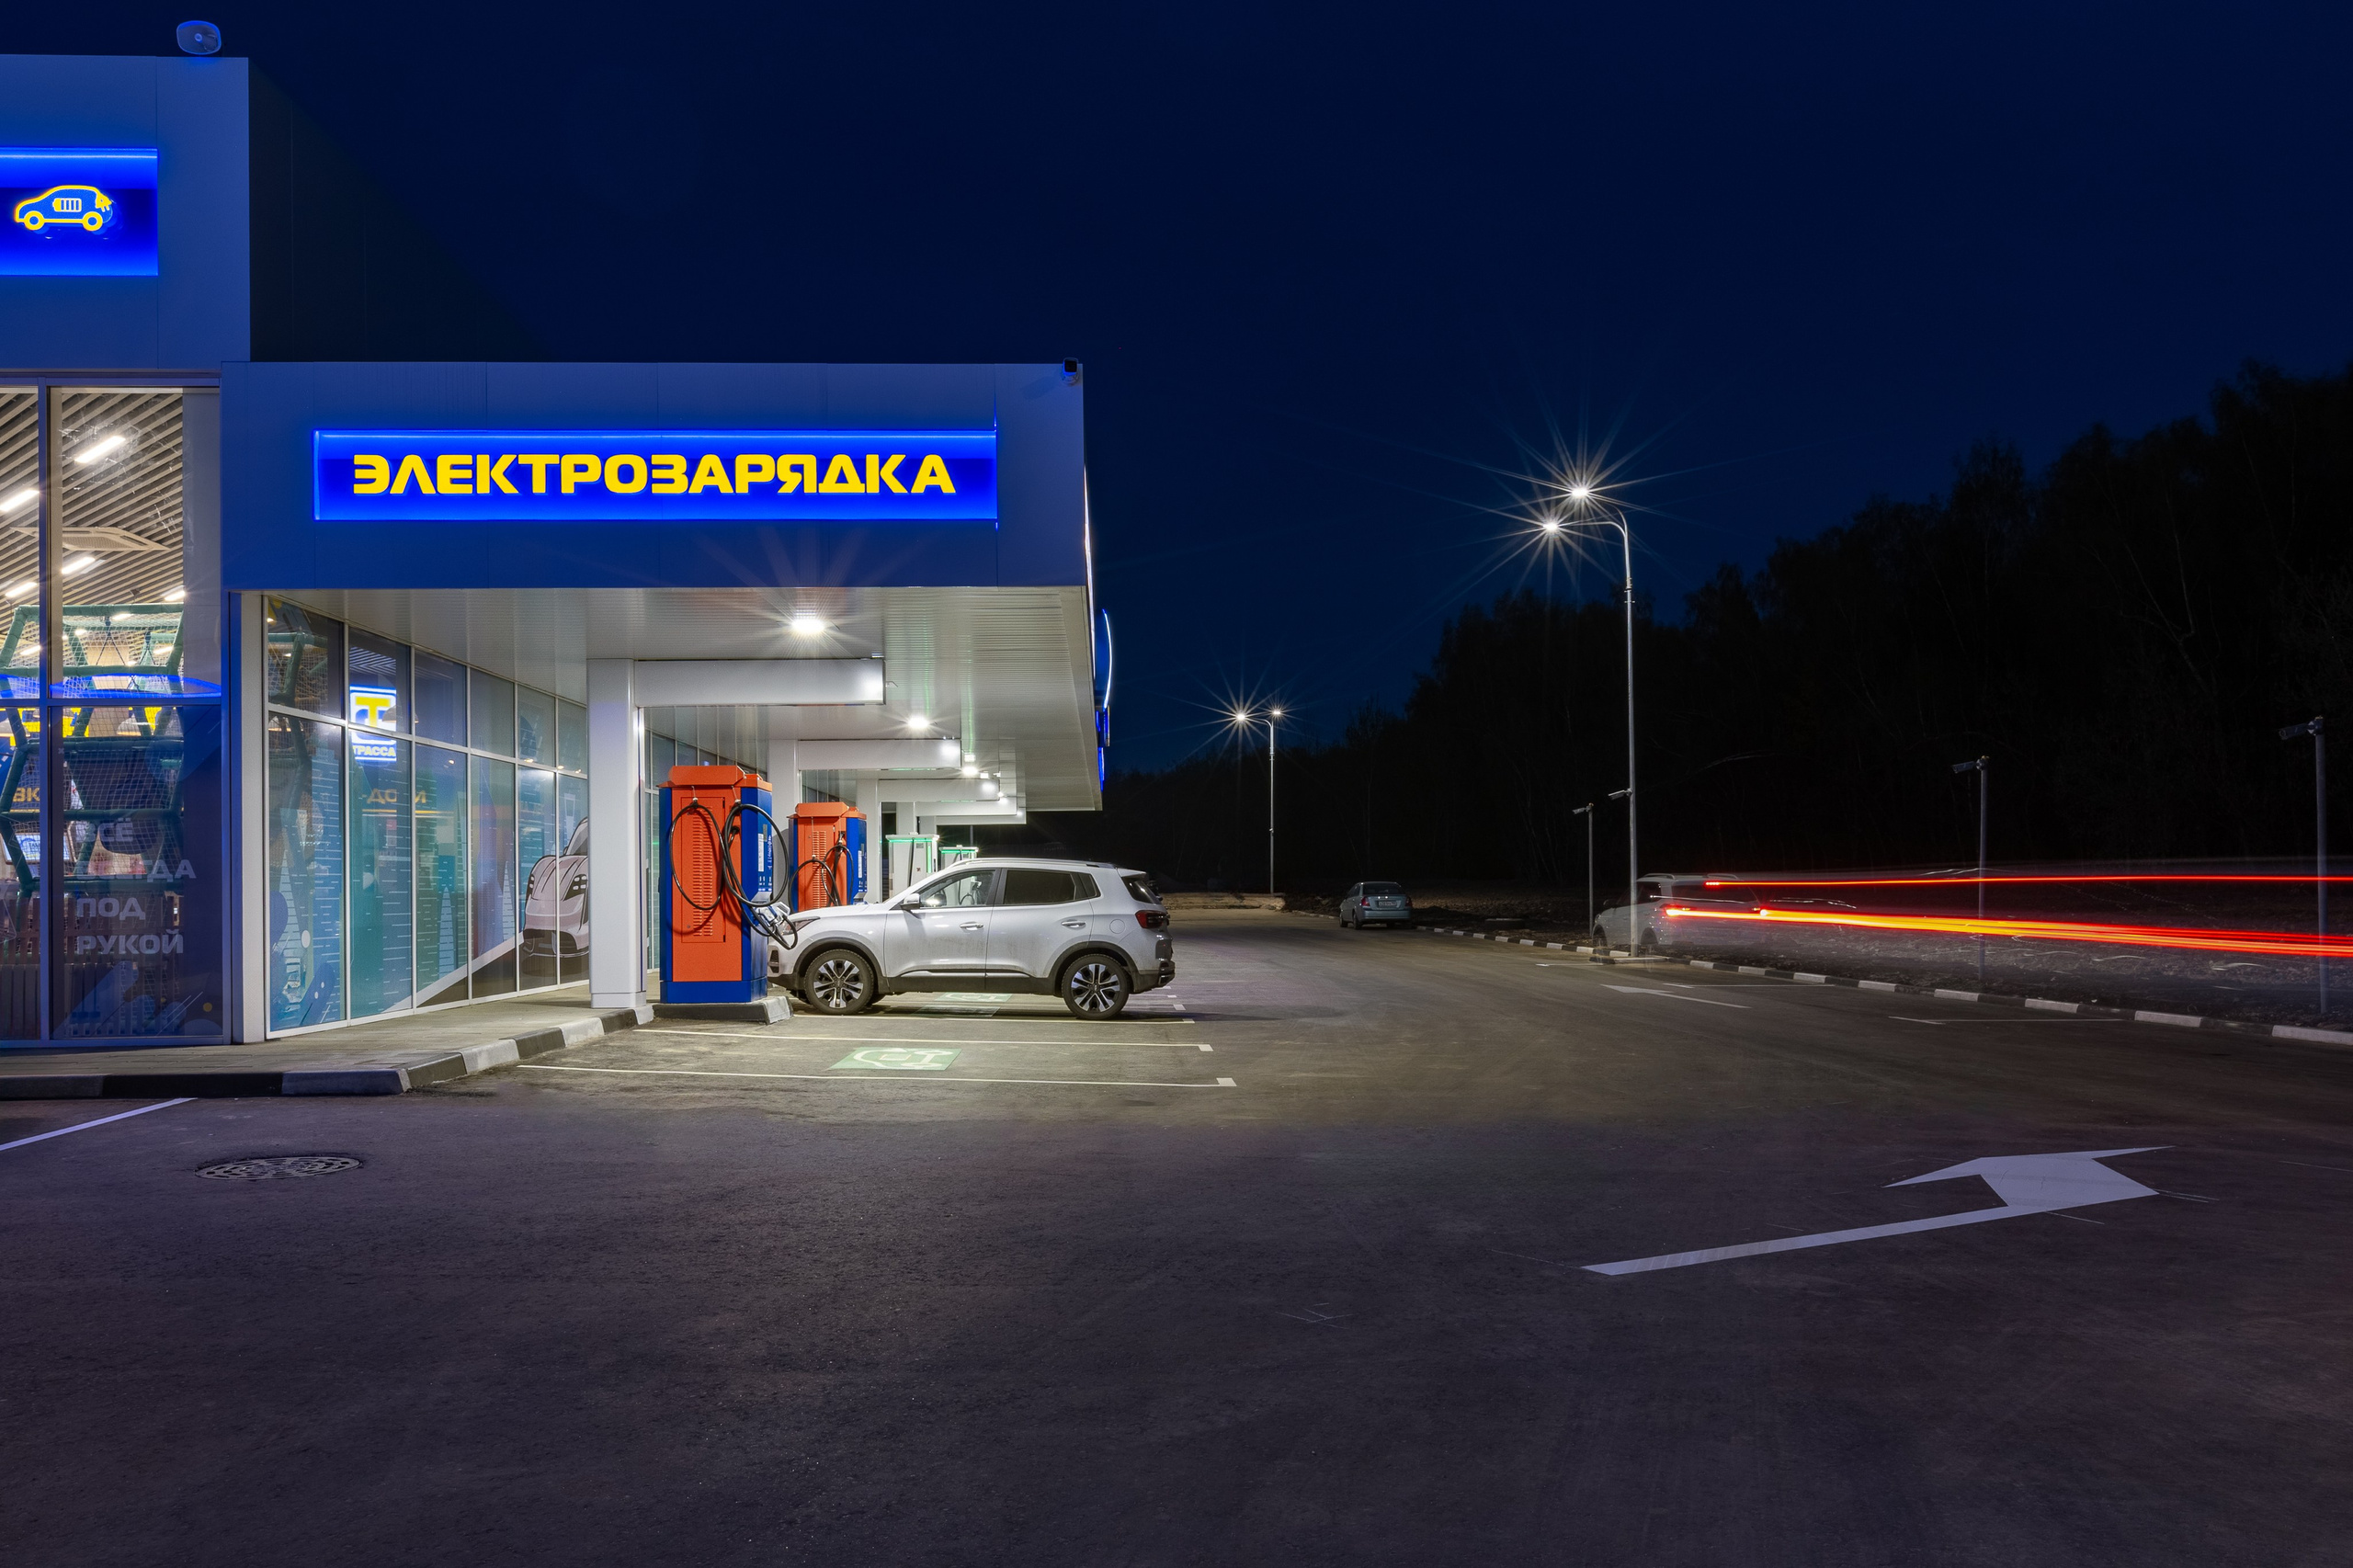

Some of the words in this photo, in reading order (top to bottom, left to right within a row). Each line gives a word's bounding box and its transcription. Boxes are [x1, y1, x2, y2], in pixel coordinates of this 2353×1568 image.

[353, 454, 956, 494] ЭЛЕКТРОЗАРЯДКА
[353, 745, 396, 756] ТРАССА
[76, 897, 146, 921] ПОД
[78, 928, 184, 955] РУКОЙ
